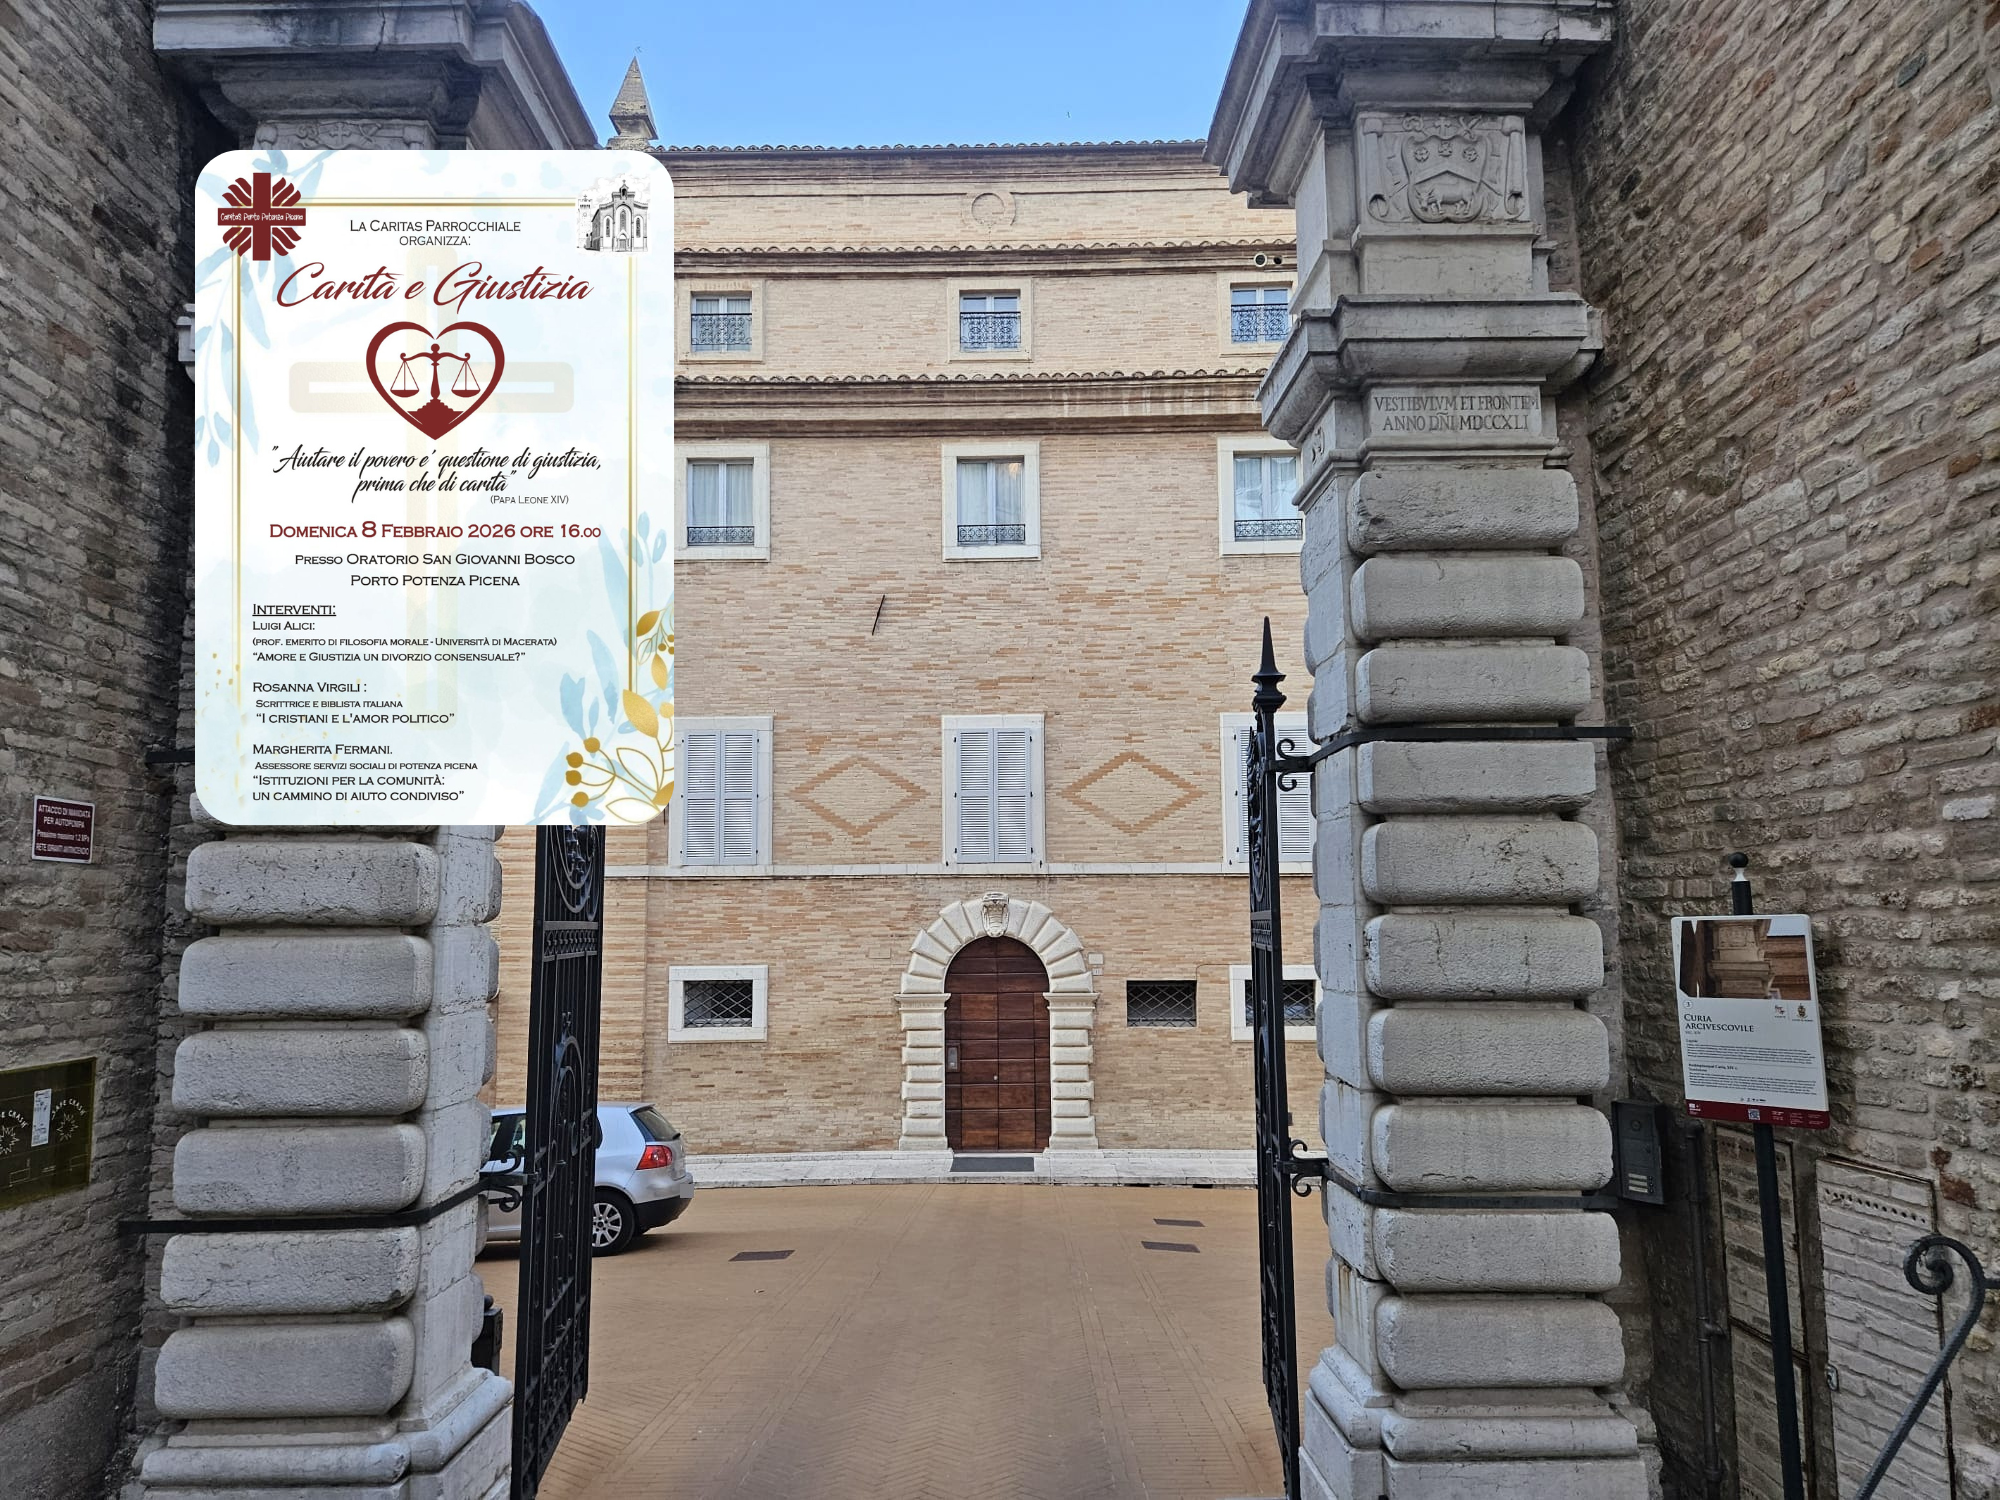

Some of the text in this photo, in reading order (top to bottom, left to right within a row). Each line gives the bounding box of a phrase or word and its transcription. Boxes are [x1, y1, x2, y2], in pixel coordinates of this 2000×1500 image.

[1374, 395, 1457, 412] VESTIBVLVM
[1460, 395, 1475, 411] ET
[1382, 414, 1426, 431] ANNO
[1459, 413, 1529, 431] MDCCXLI
[38, 804, 62, 814] ATTACCO
[43, 816, 55, 825] PER
[1683, 1013, 1713, 1023] CURIA
[1684, 1022, 1755, 1033] ARCIVESCOVILE
[8, 1109, 29, 1129] CRASH
